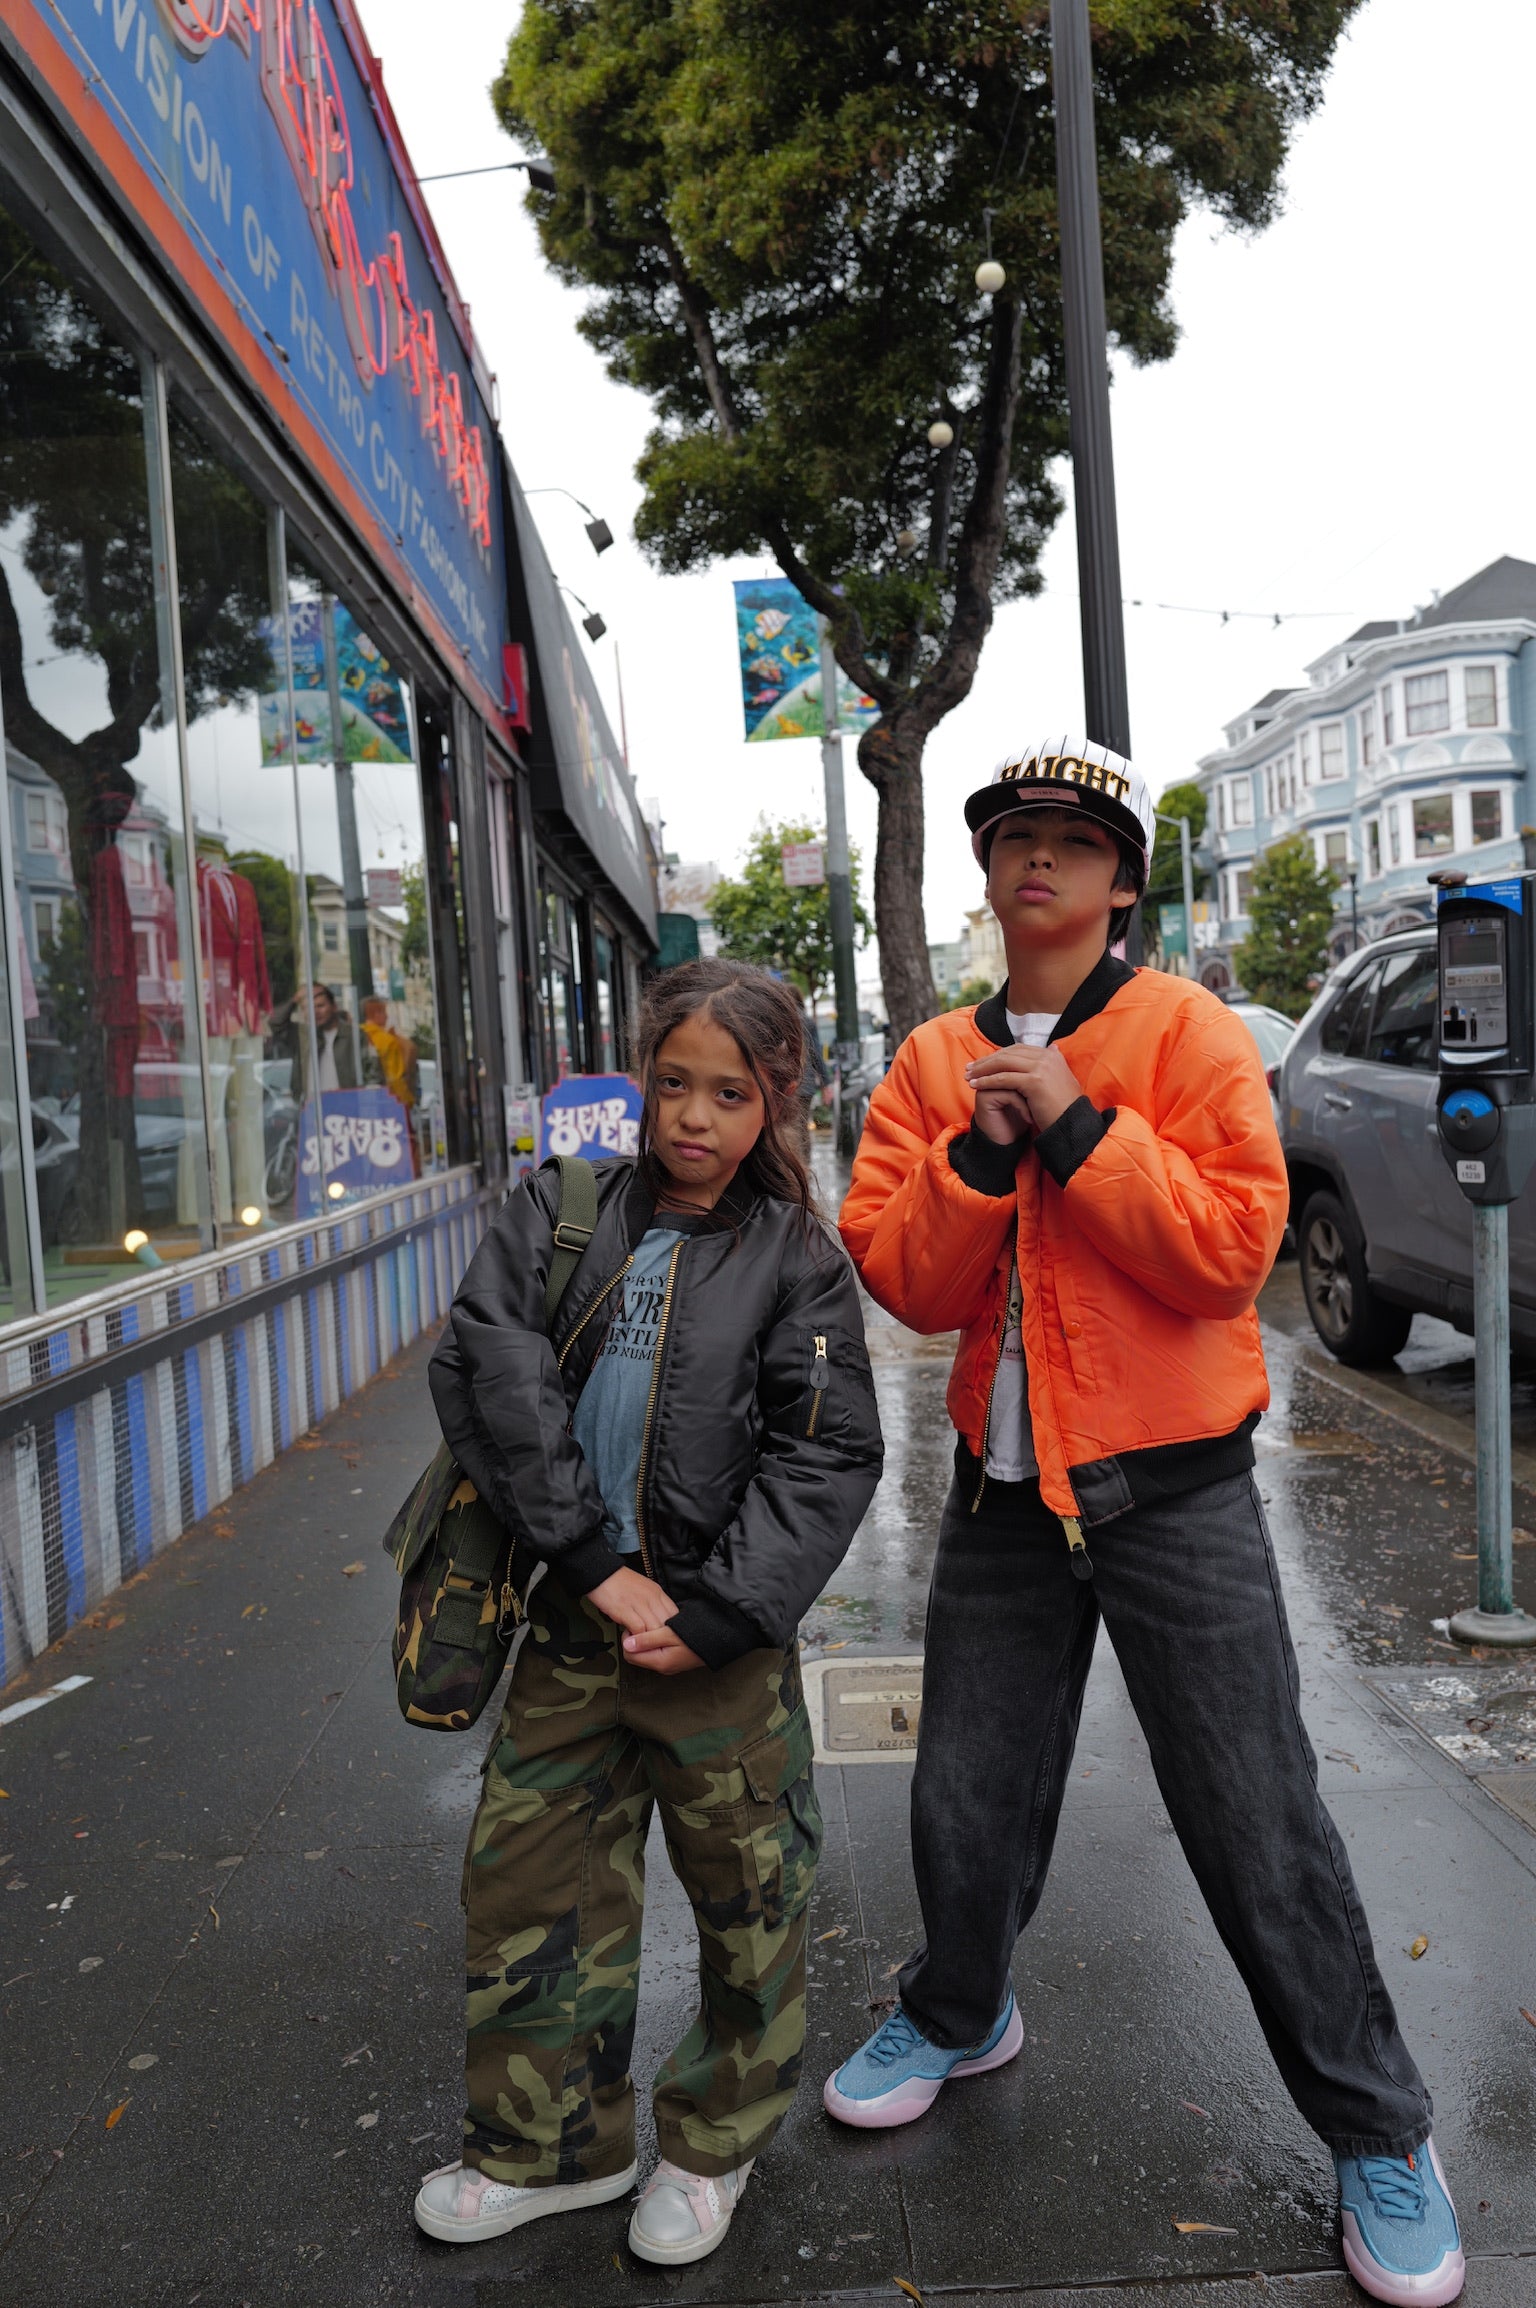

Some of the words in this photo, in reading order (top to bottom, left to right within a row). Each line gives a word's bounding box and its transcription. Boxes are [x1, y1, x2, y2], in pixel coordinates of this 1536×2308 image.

[94, 0, 232, 227] VISION
[242, 203, 281, 292] OF
[290, 271, 366, 448] RETRO
[370, 420, 409, 531] CITY
[1000, 755, 1130, 801] HAIGHT
[546, 1097, 628, 1127] HELD
[549, 1117, 640, 1158] OVER
